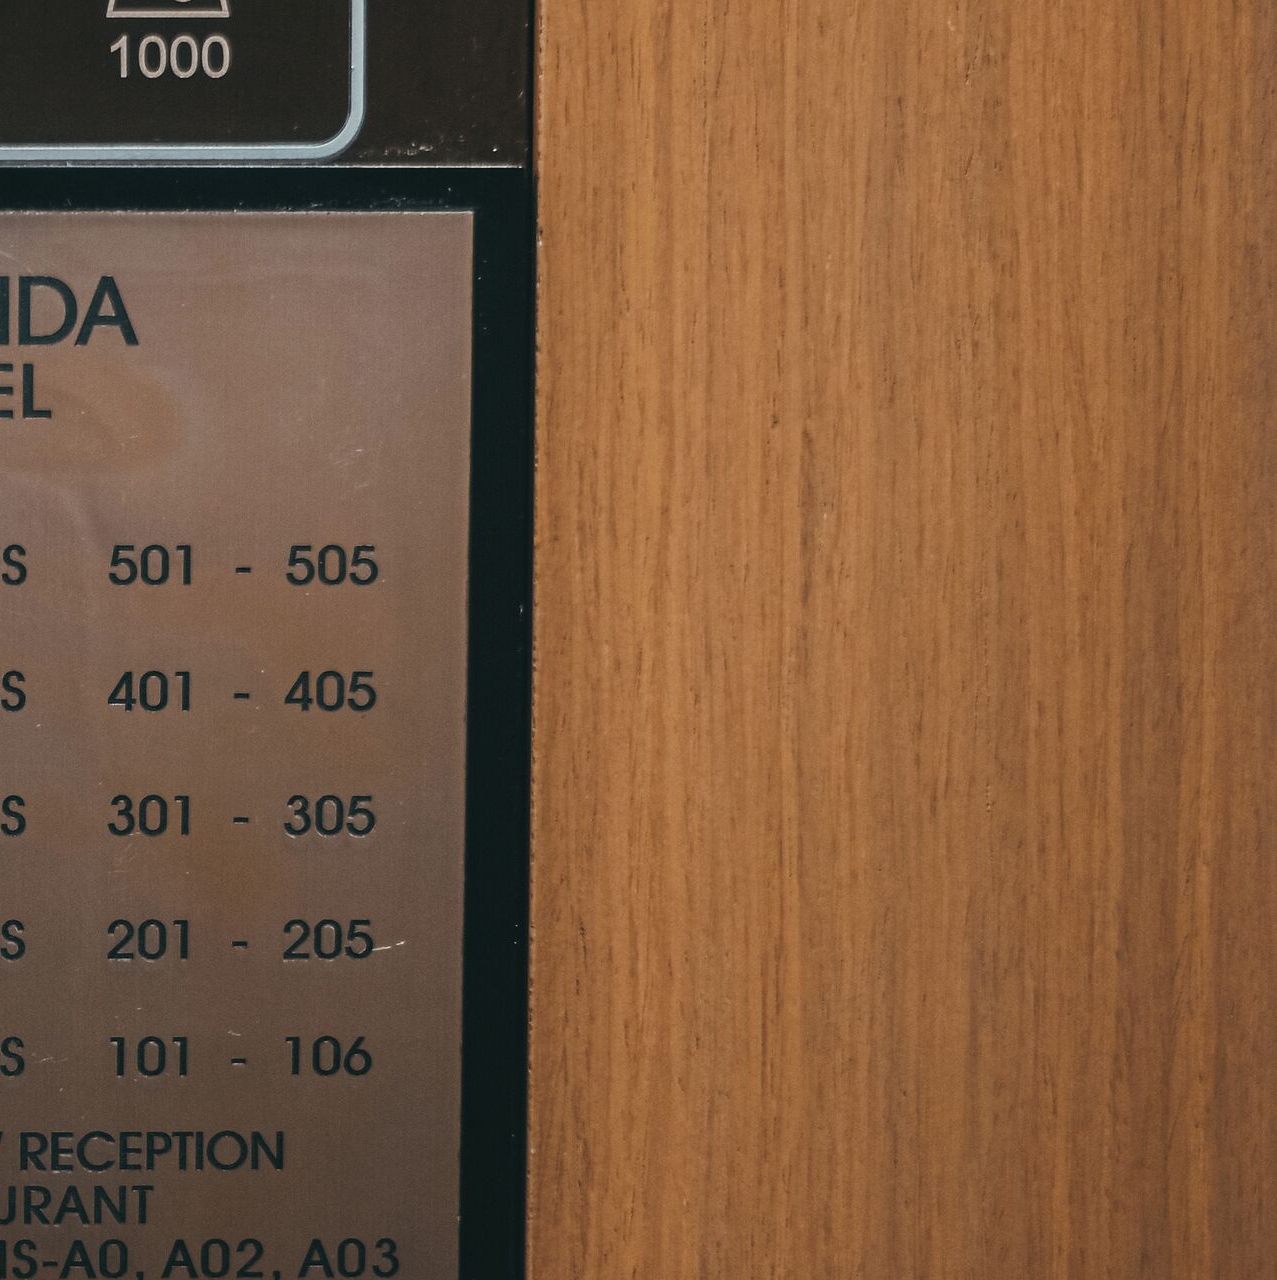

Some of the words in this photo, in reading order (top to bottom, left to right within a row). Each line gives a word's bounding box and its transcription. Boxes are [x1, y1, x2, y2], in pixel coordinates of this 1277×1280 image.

[110, 33, 231, 79] 1000
[108, 543, 192, 586] 501
[285, 543, 379, 587] 505
[107, 669, 191, 712] 401
[284, 669, 378, 713] 405
[107, 793, 190, 837] 301
[283, 794, 377, 836] 305
[106, 918, 190, 960] 201
[282, 918, 375, 960] 205
[109, 1034, 189, 1077] 101
[285, 1034, 373, 1077] 106
[19, 1129, 285, 1172] RECEPTION
[297, 1237, 401, 1279] A03
